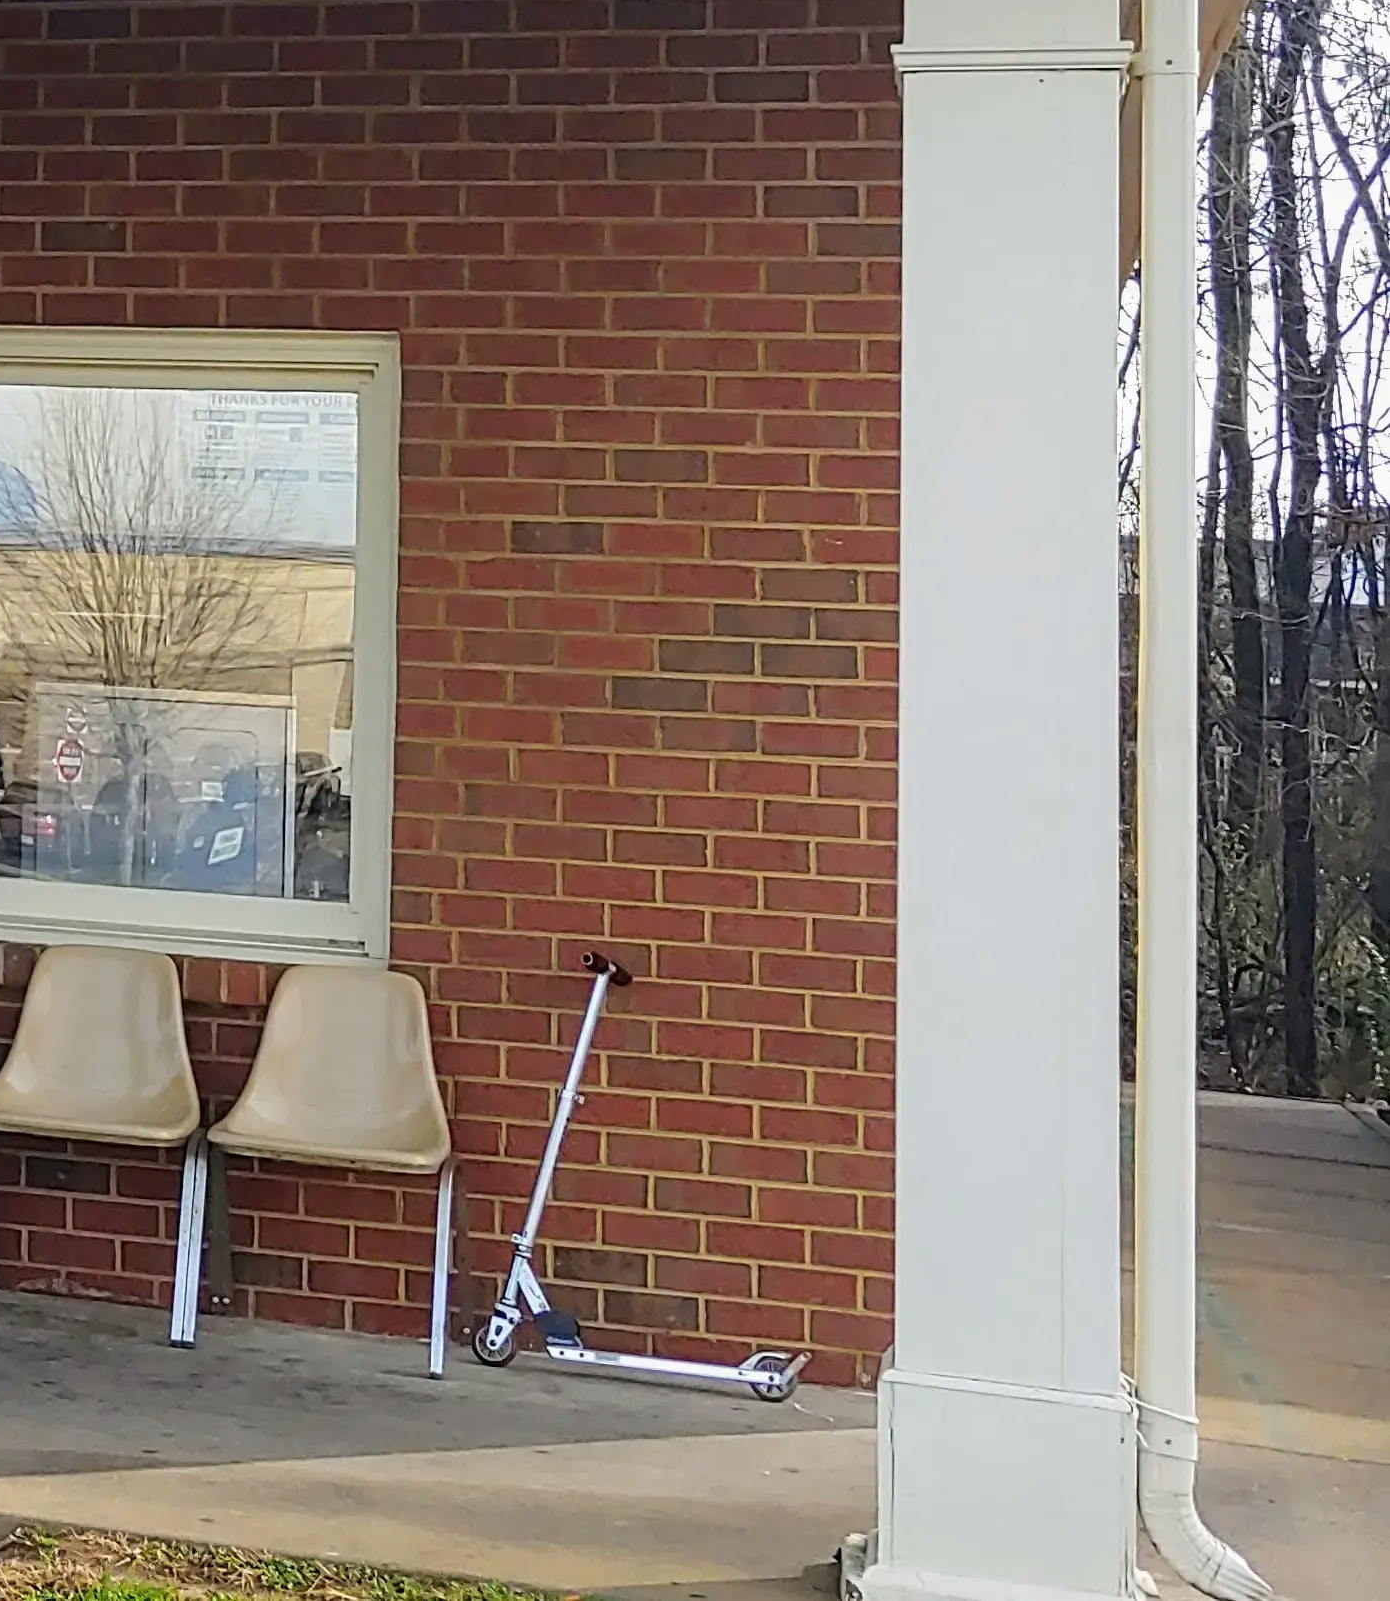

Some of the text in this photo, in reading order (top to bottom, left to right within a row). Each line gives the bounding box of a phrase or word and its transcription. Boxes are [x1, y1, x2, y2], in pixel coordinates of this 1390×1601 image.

[211, 393, 267, 406] THANKS
[271, 394, 299, 407] FOR
[303, 394, 342, 408] YOUR
